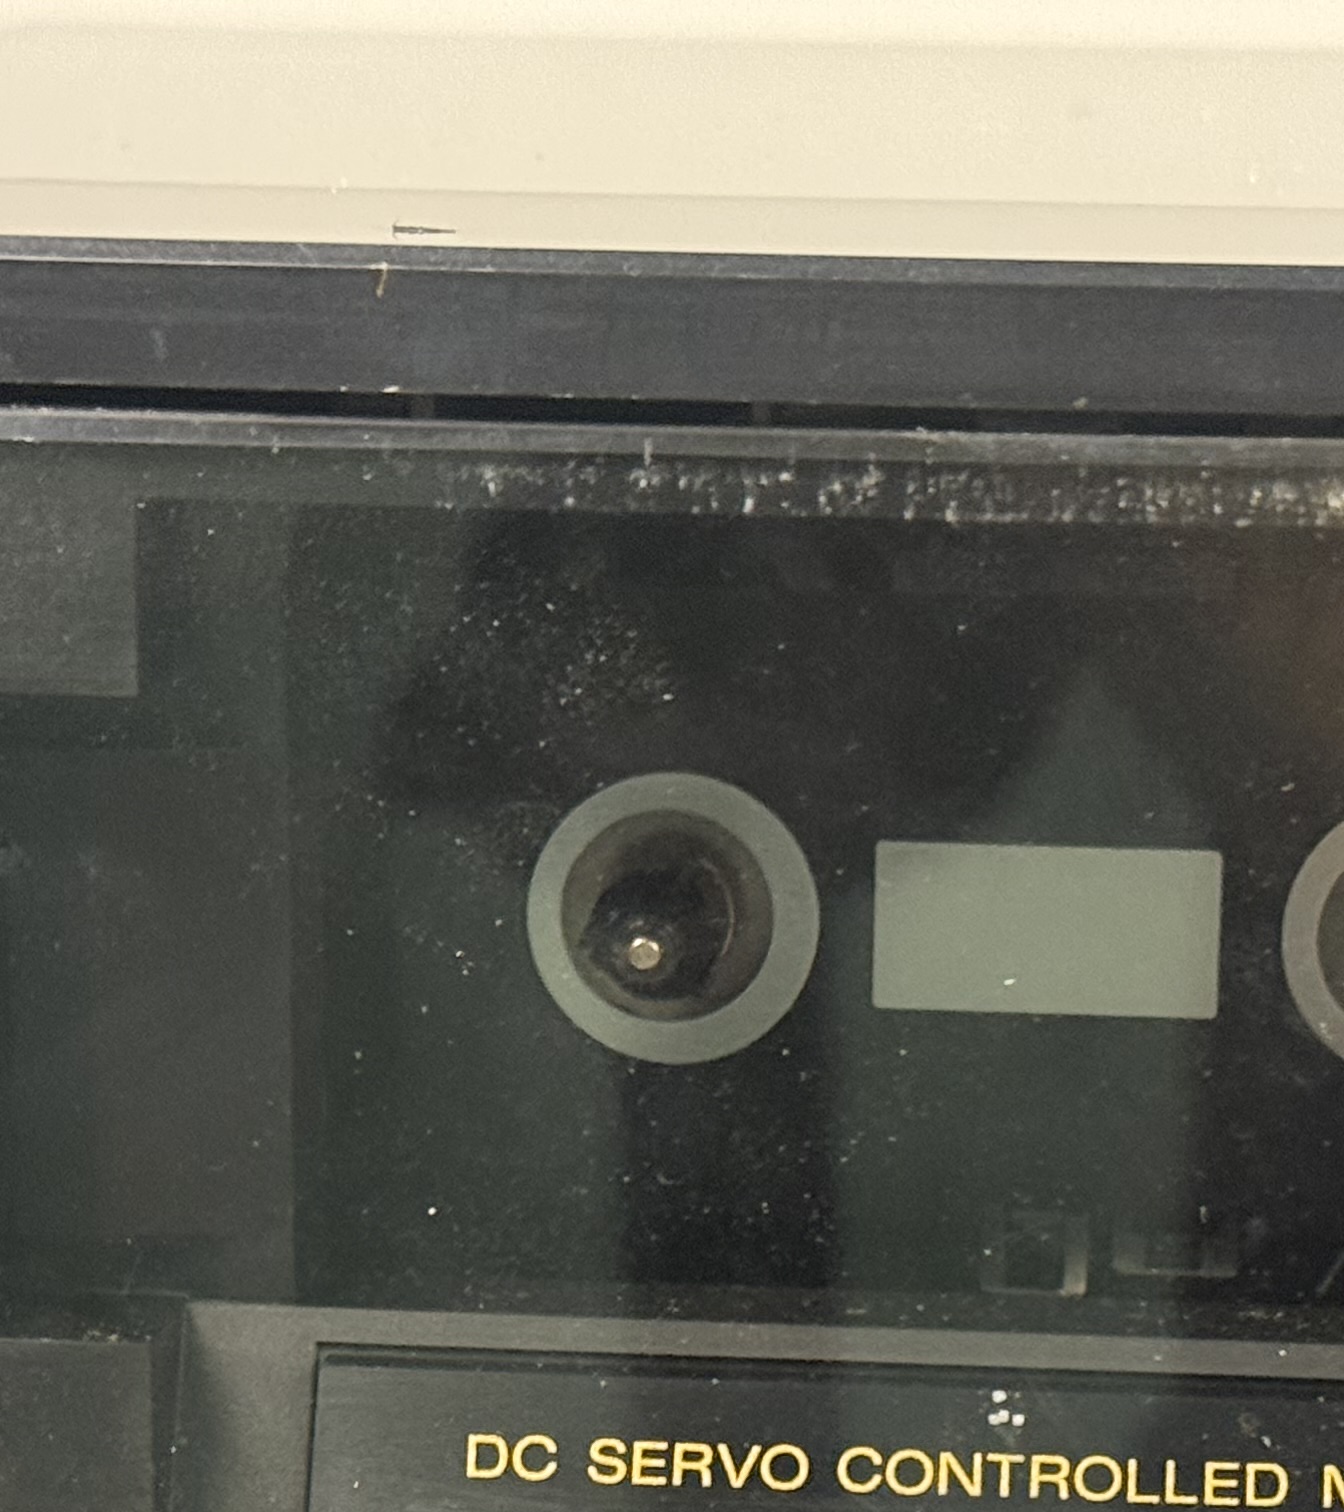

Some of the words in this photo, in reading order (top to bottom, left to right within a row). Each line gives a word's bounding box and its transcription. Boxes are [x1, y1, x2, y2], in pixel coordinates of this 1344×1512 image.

[465, 1432, 559, 1482] DC
[586, 1436, 810, 1492] SERVO
[835, 1445, 1290, 1508] CONTROLLED
